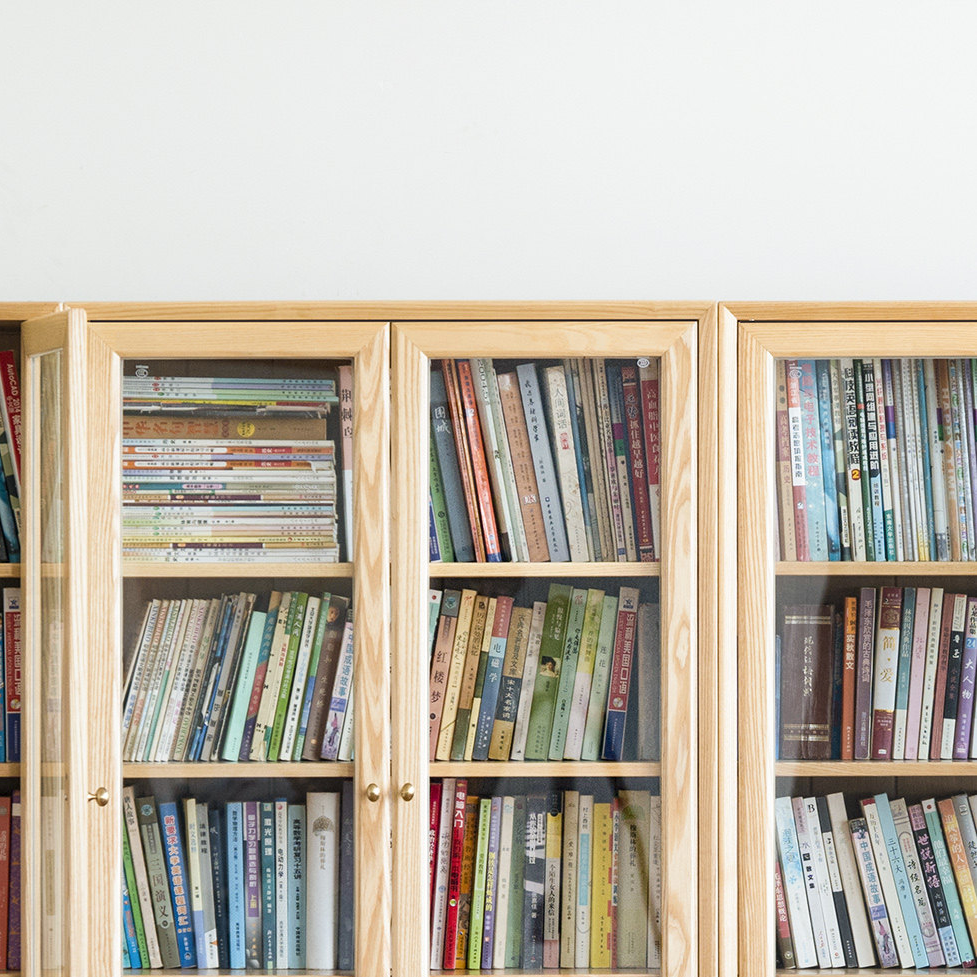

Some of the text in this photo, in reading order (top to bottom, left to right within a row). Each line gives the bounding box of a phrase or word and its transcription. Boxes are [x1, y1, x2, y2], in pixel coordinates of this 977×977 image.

[554, 389, 568, 429] 人间词话
[844, 367, 860, 465] 科技英语阅读教程
[431, 650, 448, 704] 红楼梦
[961, 657, 974, 700] 大人物
[453, 791, 466, 828] 电脑入门
[887, 838, 904, 874] 三十六大
[944, 814, 965, 863] 追风筝的人
[148, 858, 170, 918] 三国演义
[860, 841, 881, 904] 中国成语故事
[907, 859, 927, 908] 诗经名篇
